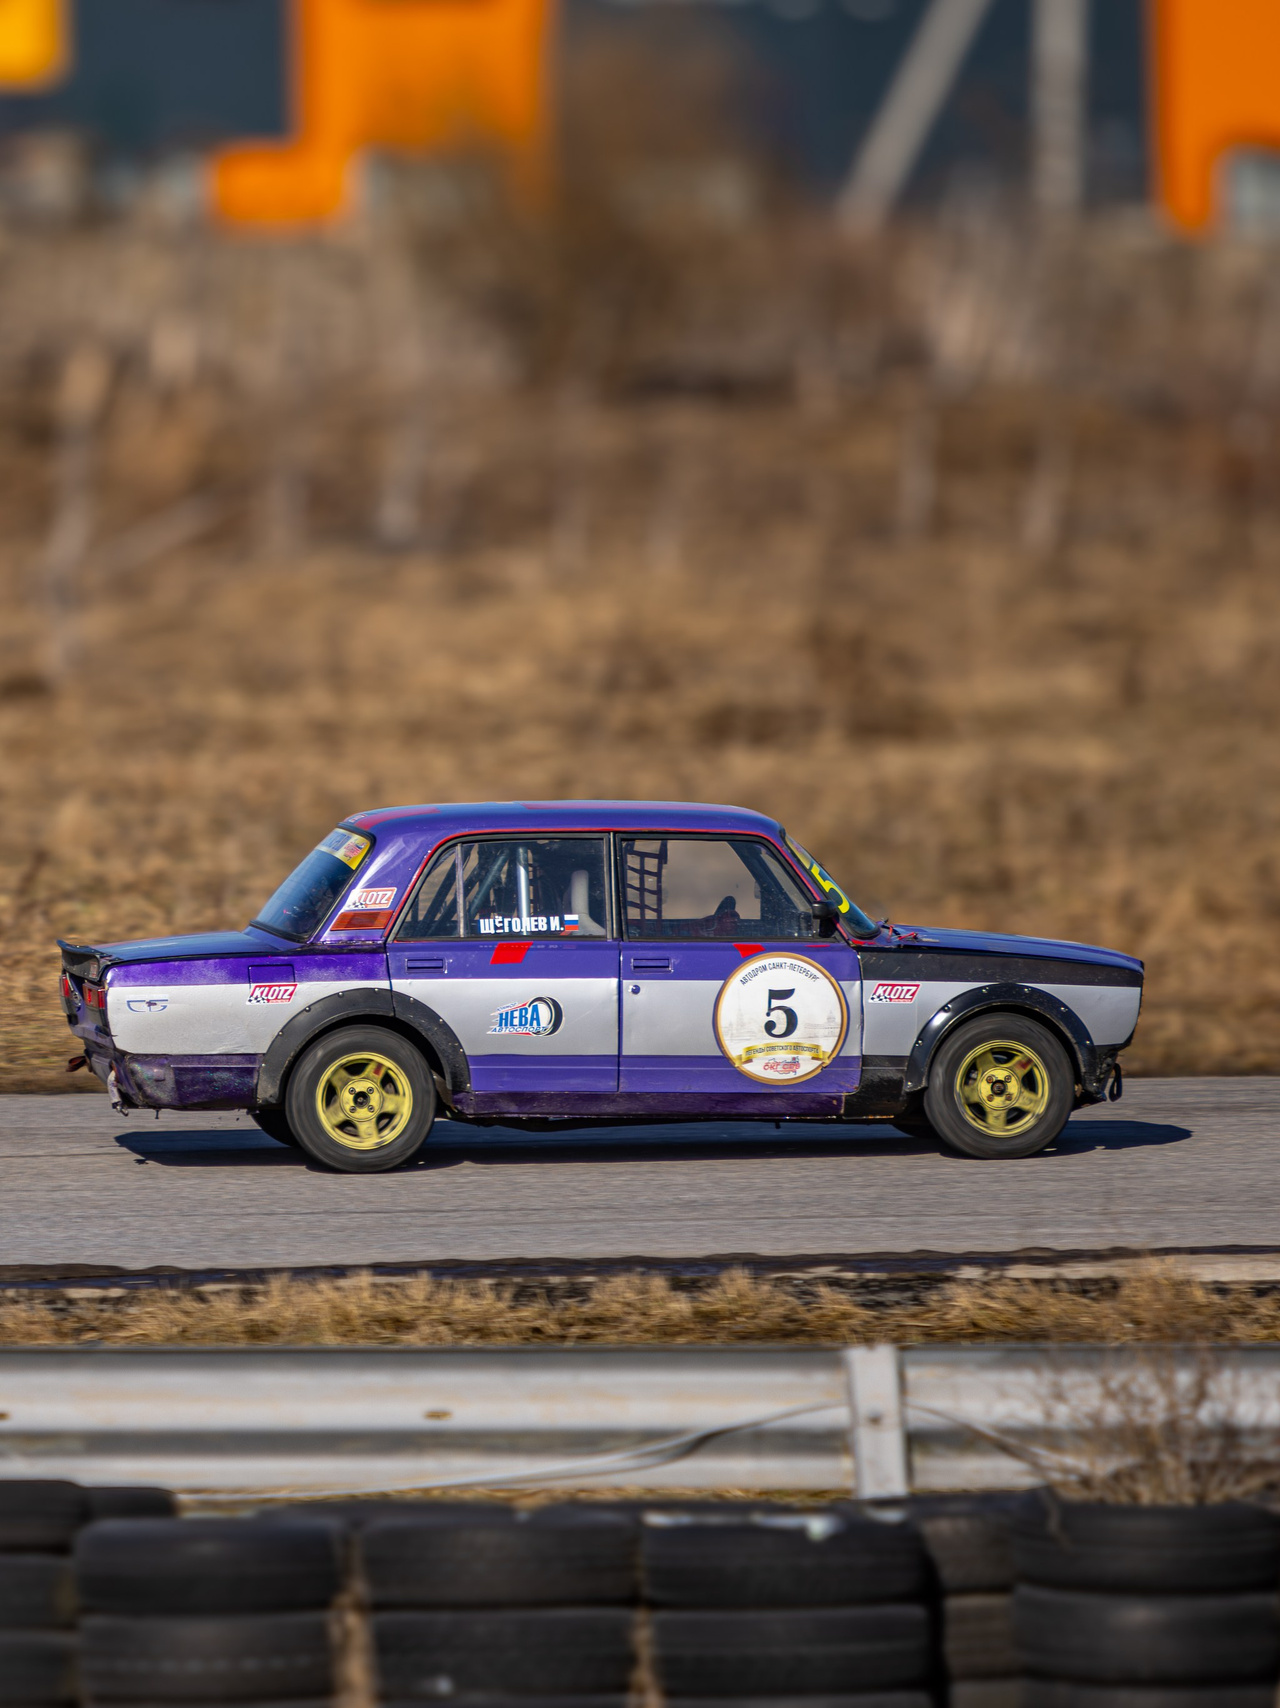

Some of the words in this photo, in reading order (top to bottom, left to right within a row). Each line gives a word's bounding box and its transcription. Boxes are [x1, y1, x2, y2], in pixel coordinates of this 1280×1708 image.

[811, 863, 850, 914] 5
[740, 964, 768, 985] АВТОДРОМ
[768, 962, 819, 982] САНКТ-ПЕТЕРБУРГ
[252, 985, 295, 1000] KLOTZ
[875, 985, 917, 999] KLOTZ
[497, 1003, 541, 1027] НЕВА
[764, 988, 798, 1038] 5
